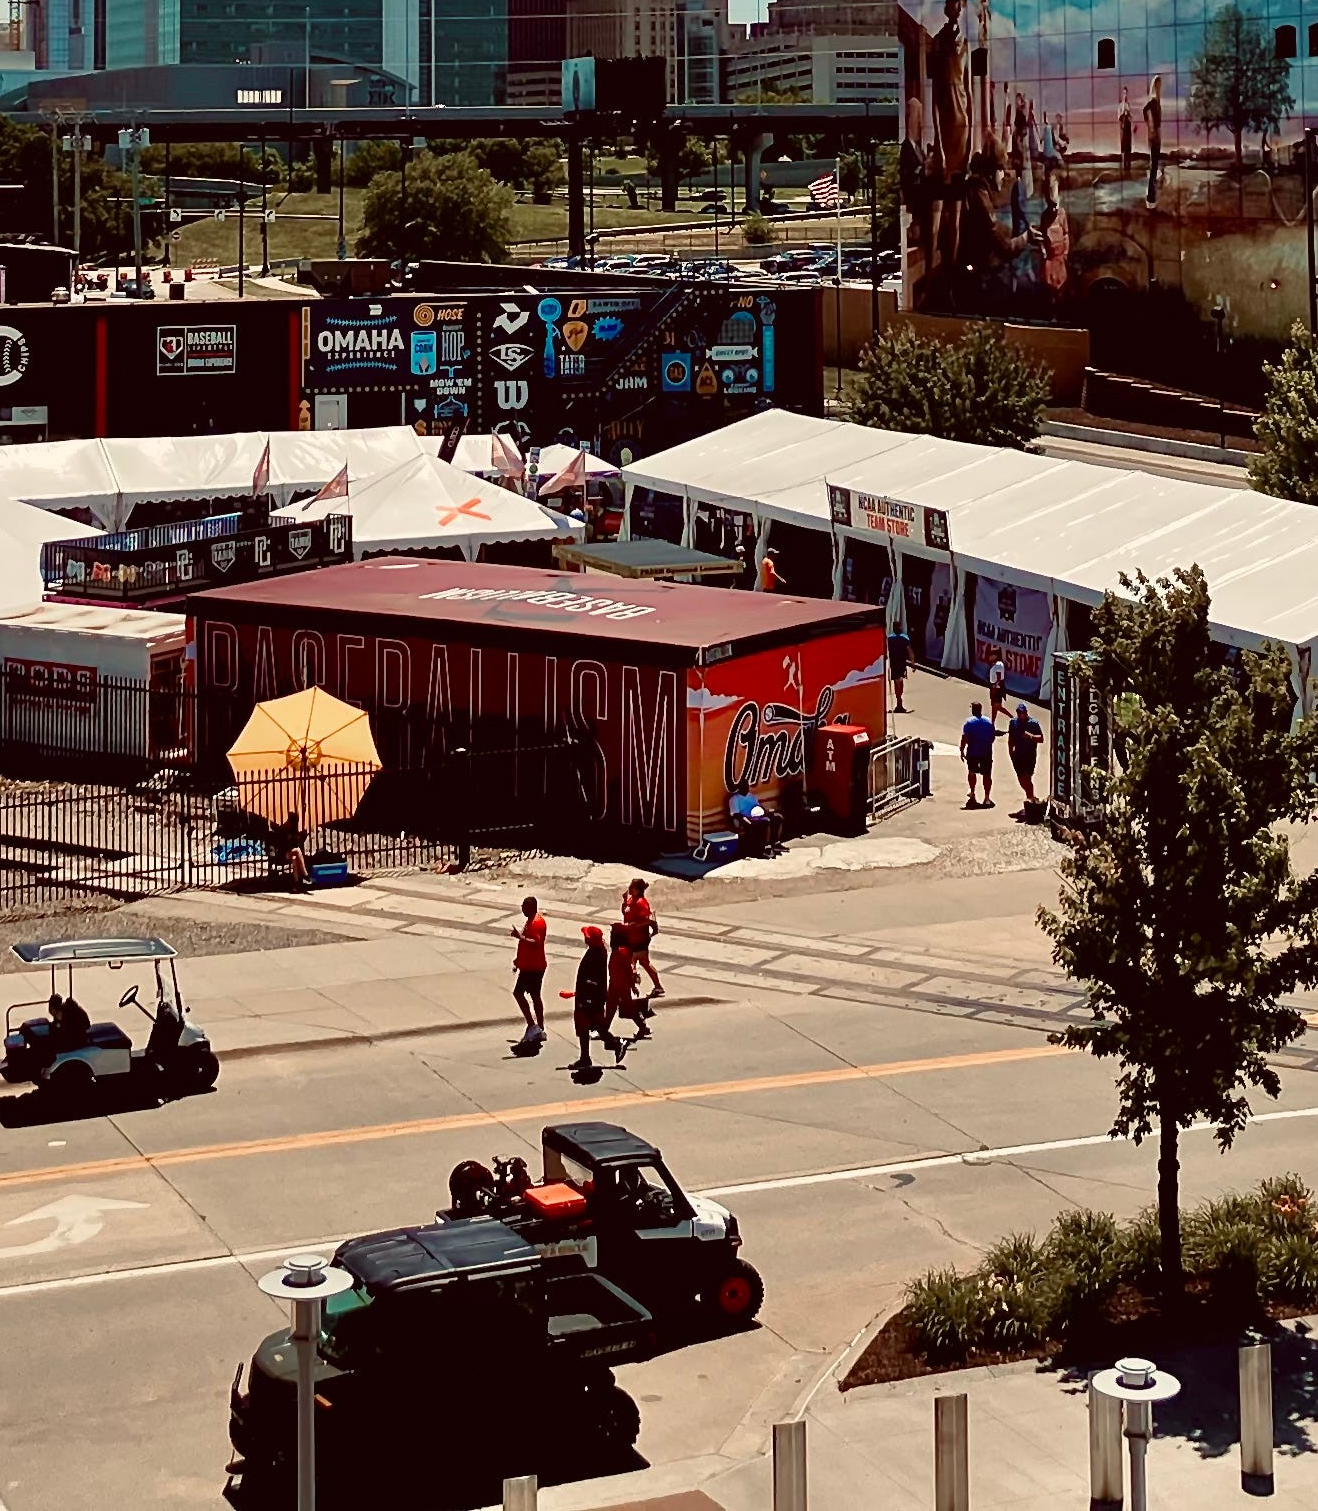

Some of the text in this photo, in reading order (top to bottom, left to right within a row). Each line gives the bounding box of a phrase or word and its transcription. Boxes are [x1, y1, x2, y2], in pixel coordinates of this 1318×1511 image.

[436, 308, 465, 321] HOSE
[187, 331, 233, 345] BASEBALL
[317, 328, 405, 352] OMAHA
[441, 330, 465, 362] HOP
[327, 351, 396, 359] EXPERIENCE
[436, 387, 466, 396] DOWN
[615, 375, 648, 389] JAM
[858, 494, 915, 522] NCAA AUTHENTIC
[866, 512, 910, 538] TEAM STORE
[418, 585, 658, 620] BASEBALLISM
[1056, 670, 1067, 797] ENTRANCE
[825, 738, 836, 772] ATM
[1088, 756, 1101, 800] FNS
